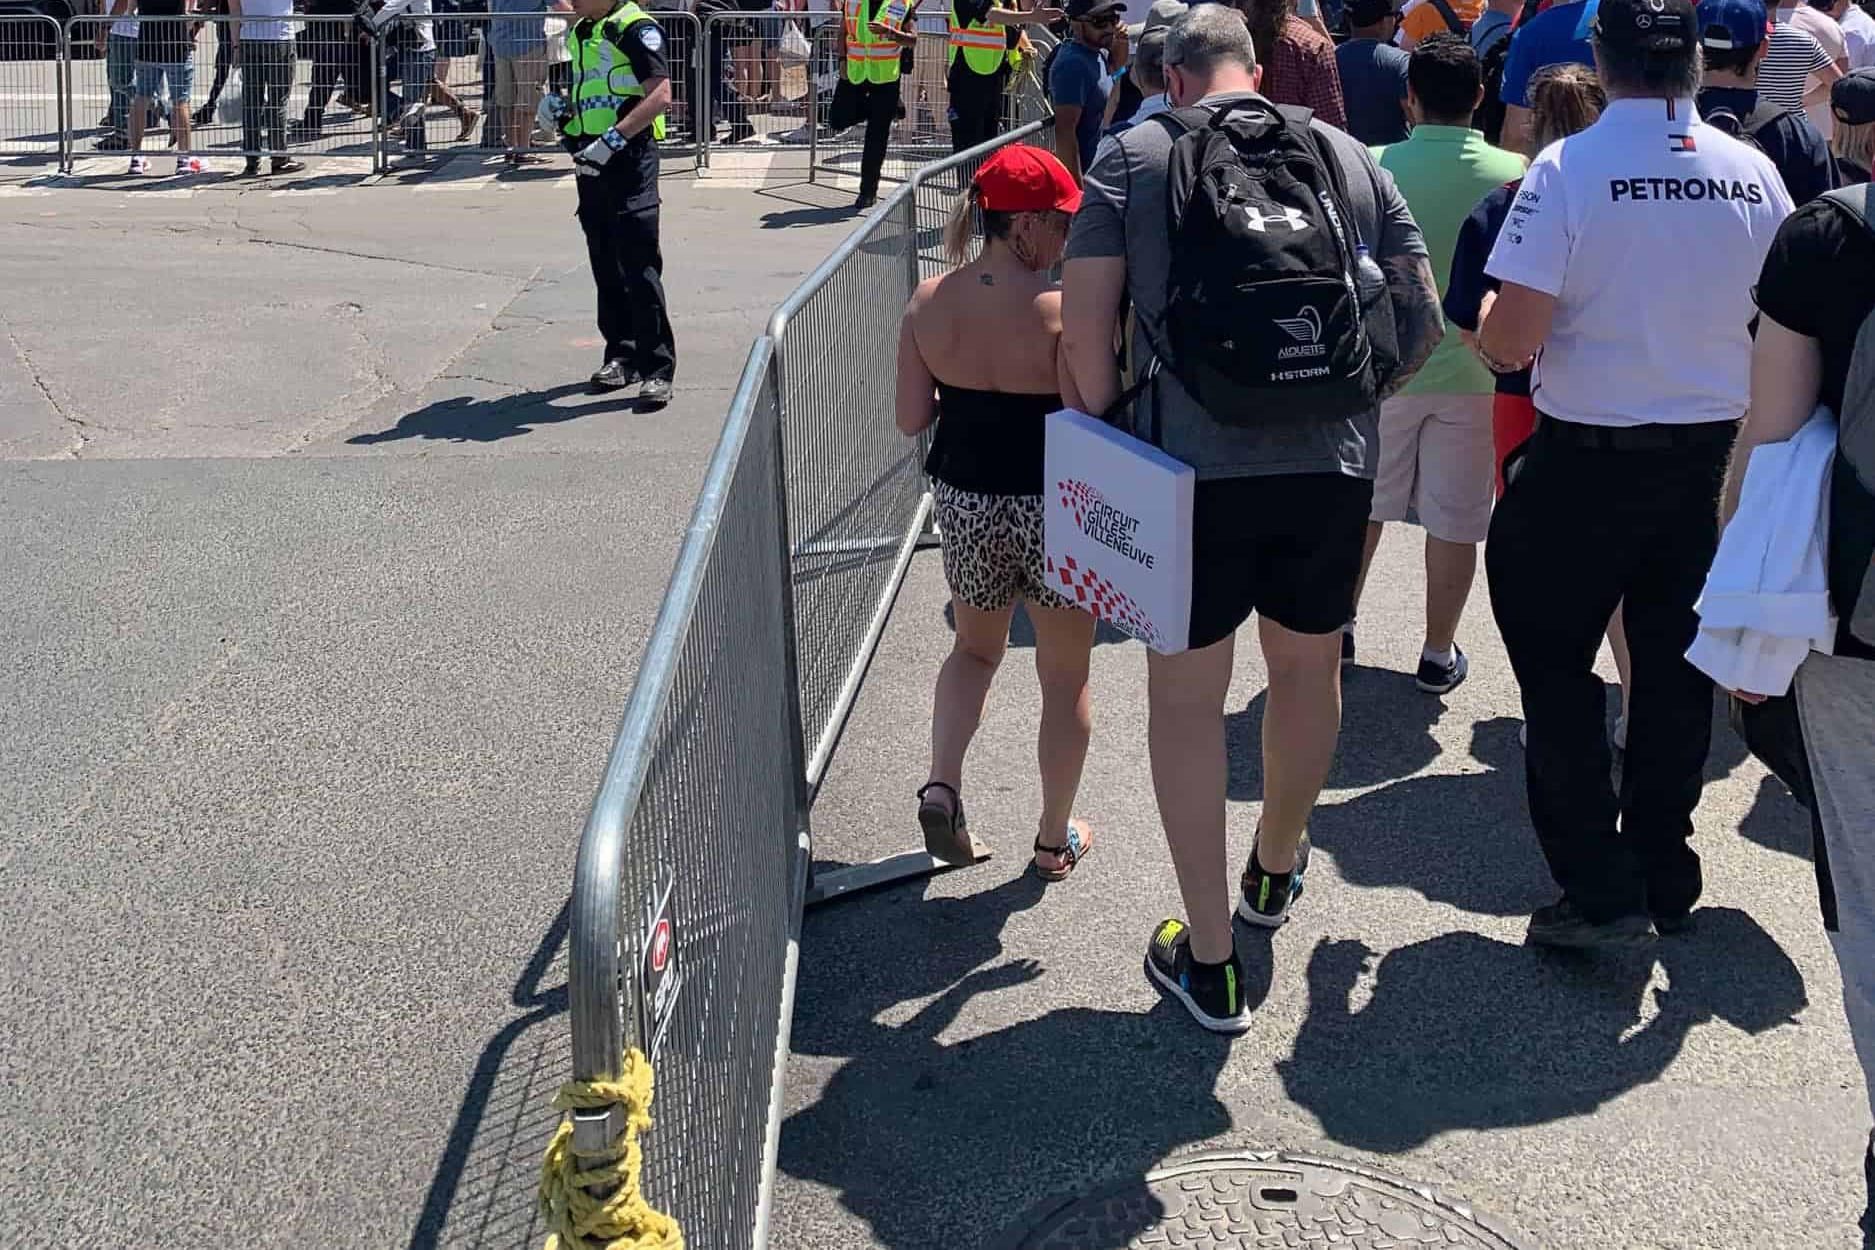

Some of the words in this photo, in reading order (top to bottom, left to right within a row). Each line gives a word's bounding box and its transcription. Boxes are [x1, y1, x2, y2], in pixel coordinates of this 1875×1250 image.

[1610, 178, 1763, 204] PETRONAS
[1278, 344, 1326, 359] ALOUETTE
[1087, 510, 1133, 541] GILLES-
[1093, 500, 1140, 533] CIRCUIT
[1084, 521, 1154, 569] VILLENEUVE
